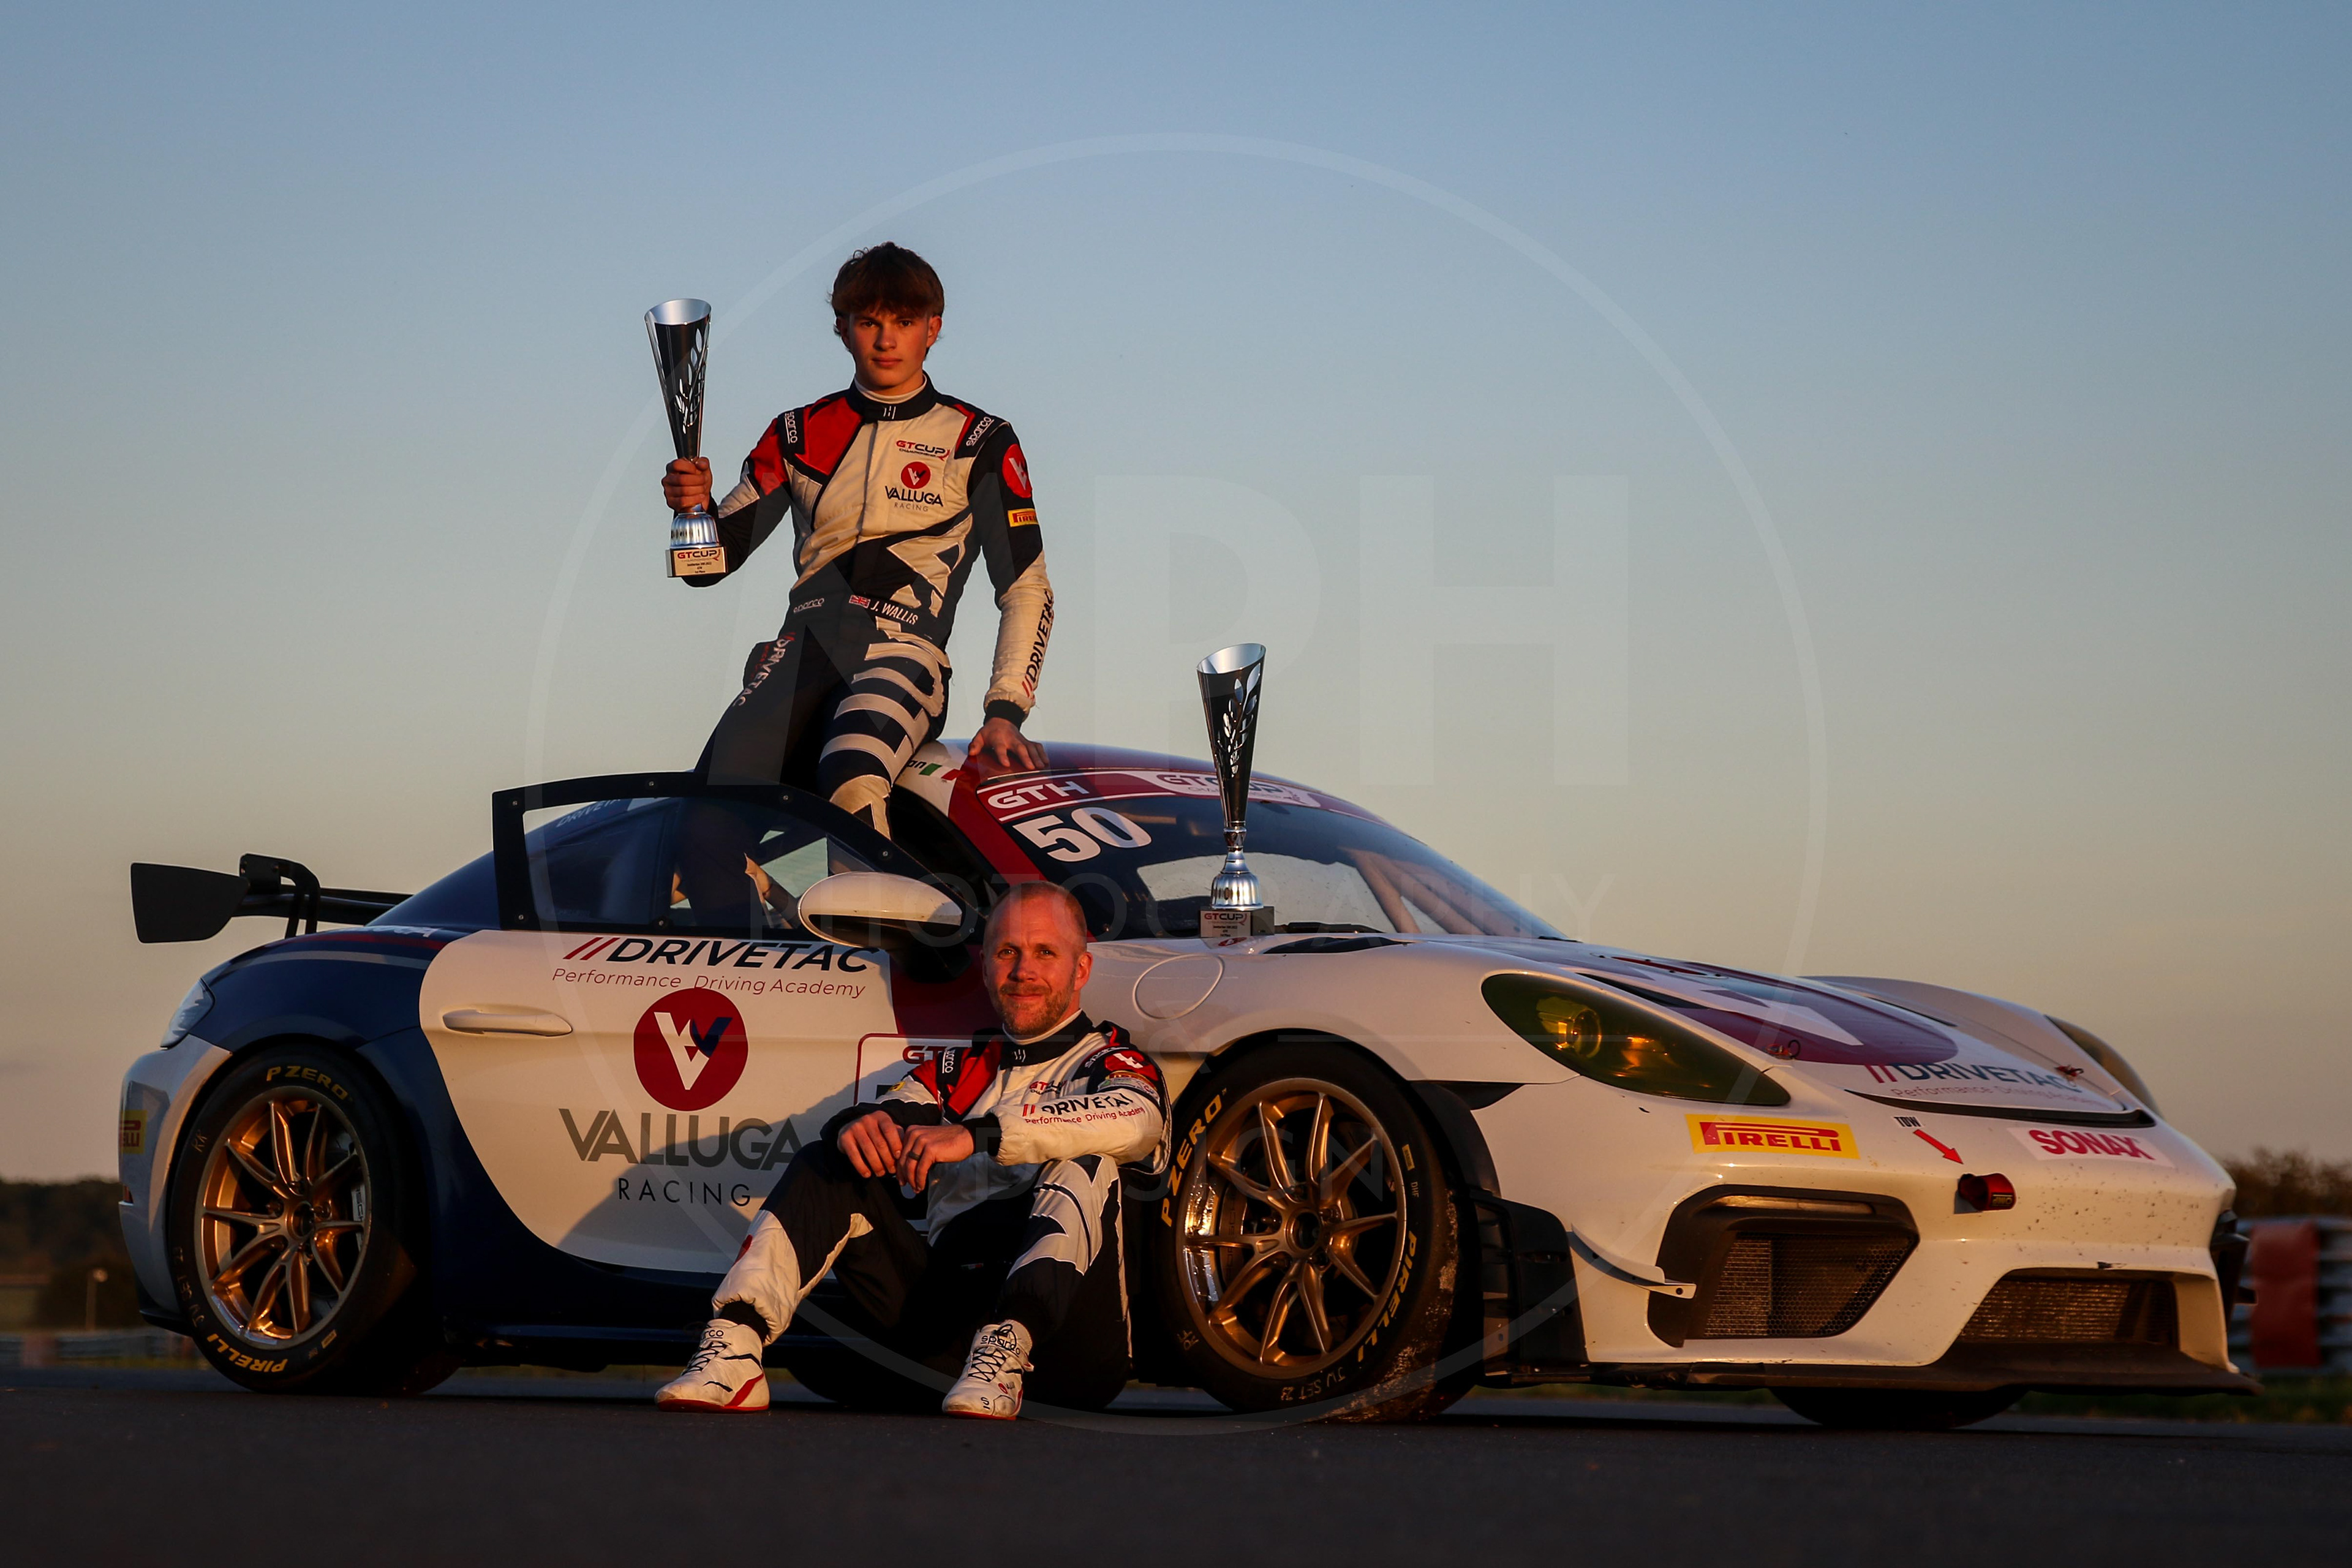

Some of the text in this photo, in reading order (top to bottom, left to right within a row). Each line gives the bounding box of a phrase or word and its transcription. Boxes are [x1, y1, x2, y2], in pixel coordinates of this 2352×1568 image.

[785, 411, 798, 443] sparco
[965, 416, 993, 447] sparco
[895, 440, 946, 454] GTCUP
[884, 485, 943, 508] VALLUGA
[894, 502, 929, 512] RACING
[677, 549, 718, 559] GTCUP
[870, 600, 919, 625] J. WALLIS
[988, 780, 1090, 810] GTH
[1012, 806, 1152, 862] 50
[1204, 912, 1244, 921] GTCUP
[551, 967, 865, 999] Performance Driving Academy
[265, 1065, 349, 1100] P ZERO
[1891, 1085, 1992, 1098] Performance
[1085, 1112, 1118, 1121] Driving
[1894, 1116, 1922, 1127] TOW
[557, 1107, 806, 1172] VALLUGA
[1698, 1120, 1842, 1153] PIRELLI
[2027, 1129, 2156, 1161] SONAX
[1161, 1101, 1224, 1227] P ZERO
[617, 1177, 752, 1207] RACING
[1357, 1230, 1417, 1362] PIRELLI
[206, 1332, 288, 1373] PIRELLI
